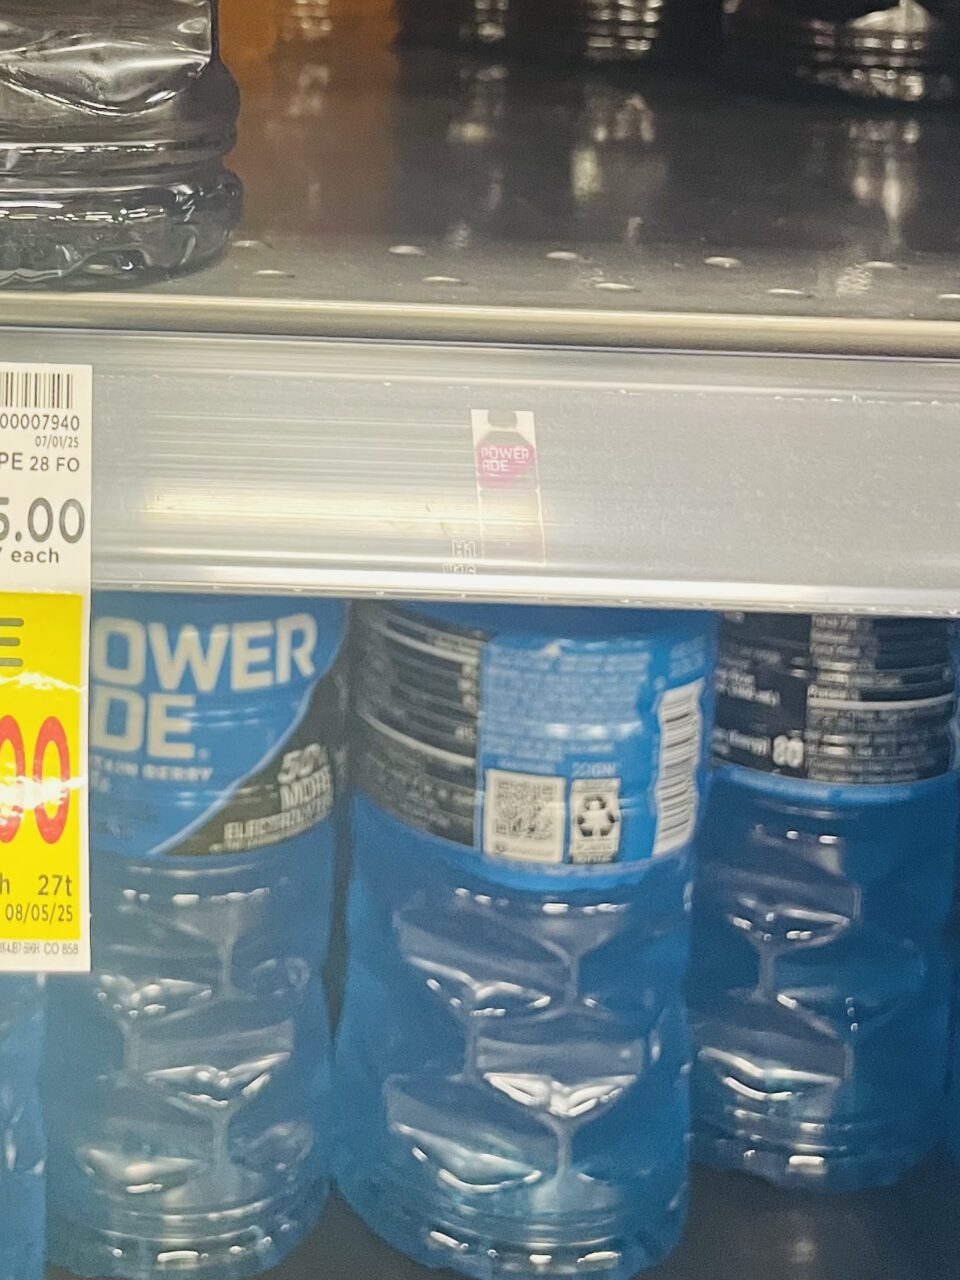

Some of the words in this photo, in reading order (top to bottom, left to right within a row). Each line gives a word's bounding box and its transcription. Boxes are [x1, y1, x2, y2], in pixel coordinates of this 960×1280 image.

[34, 435, 79, 449] 07/01/25
[481, 447, 529, 460] POWER
[30, 456, 49, 472] 28
[56, 457, 80, 473] FO
[10, 547, 60, 564] each
[91, 613, 318, 693] OWER
[90, 684, 196, 759] DE
[37, 874, 73, 897] 27t
[5, 903, 73, 925] 08/05/25
[43, 943, 59, 954] CO
